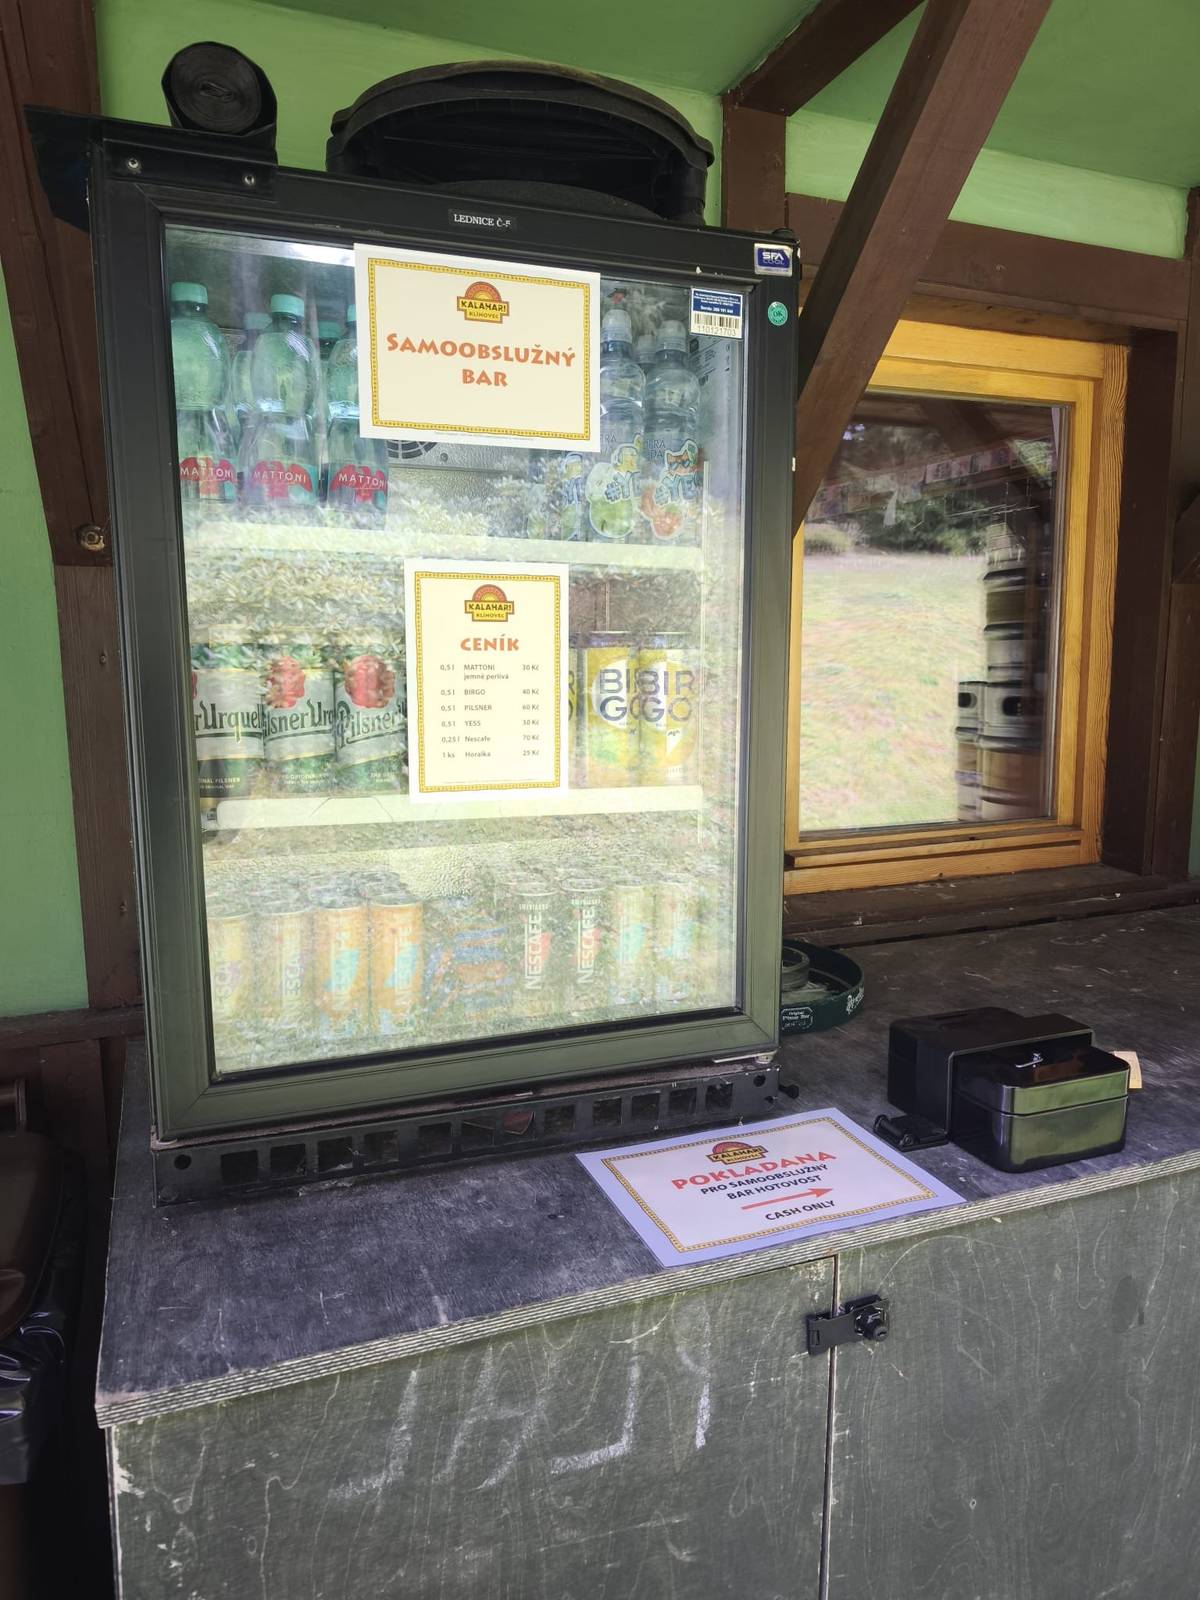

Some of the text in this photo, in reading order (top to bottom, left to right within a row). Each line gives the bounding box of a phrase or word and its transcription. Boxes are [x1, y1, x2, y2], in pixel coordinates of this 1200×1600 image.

[453, 213, 495, 226] LEDNICE
[461, 300, 506, 312] KALAHARI
[386, 332, 576, 367] SAMOOBSLUŽNÝ
[461, 368, 508, 387] BAR
[180, 466, 234, 479] MATTONI
[253, 470, 307, 484] MATTONI
[468, 603, 512, 611] KALAHARI
[460, 633, 520, 651] CENÍK
[464, 688, 486, 696] BIRGO
[712, 1148, 762, 1160] KALAHARI
[671, 1151, 837, 1190] POKLADANA
[701, 1162, 829, 1195] PRO SAMOOBSLUŽNÝ
[727, 1174, 823, 1200] BAR HOTOVOST
[764, 1199, 836, 1221] CASH ONLY
